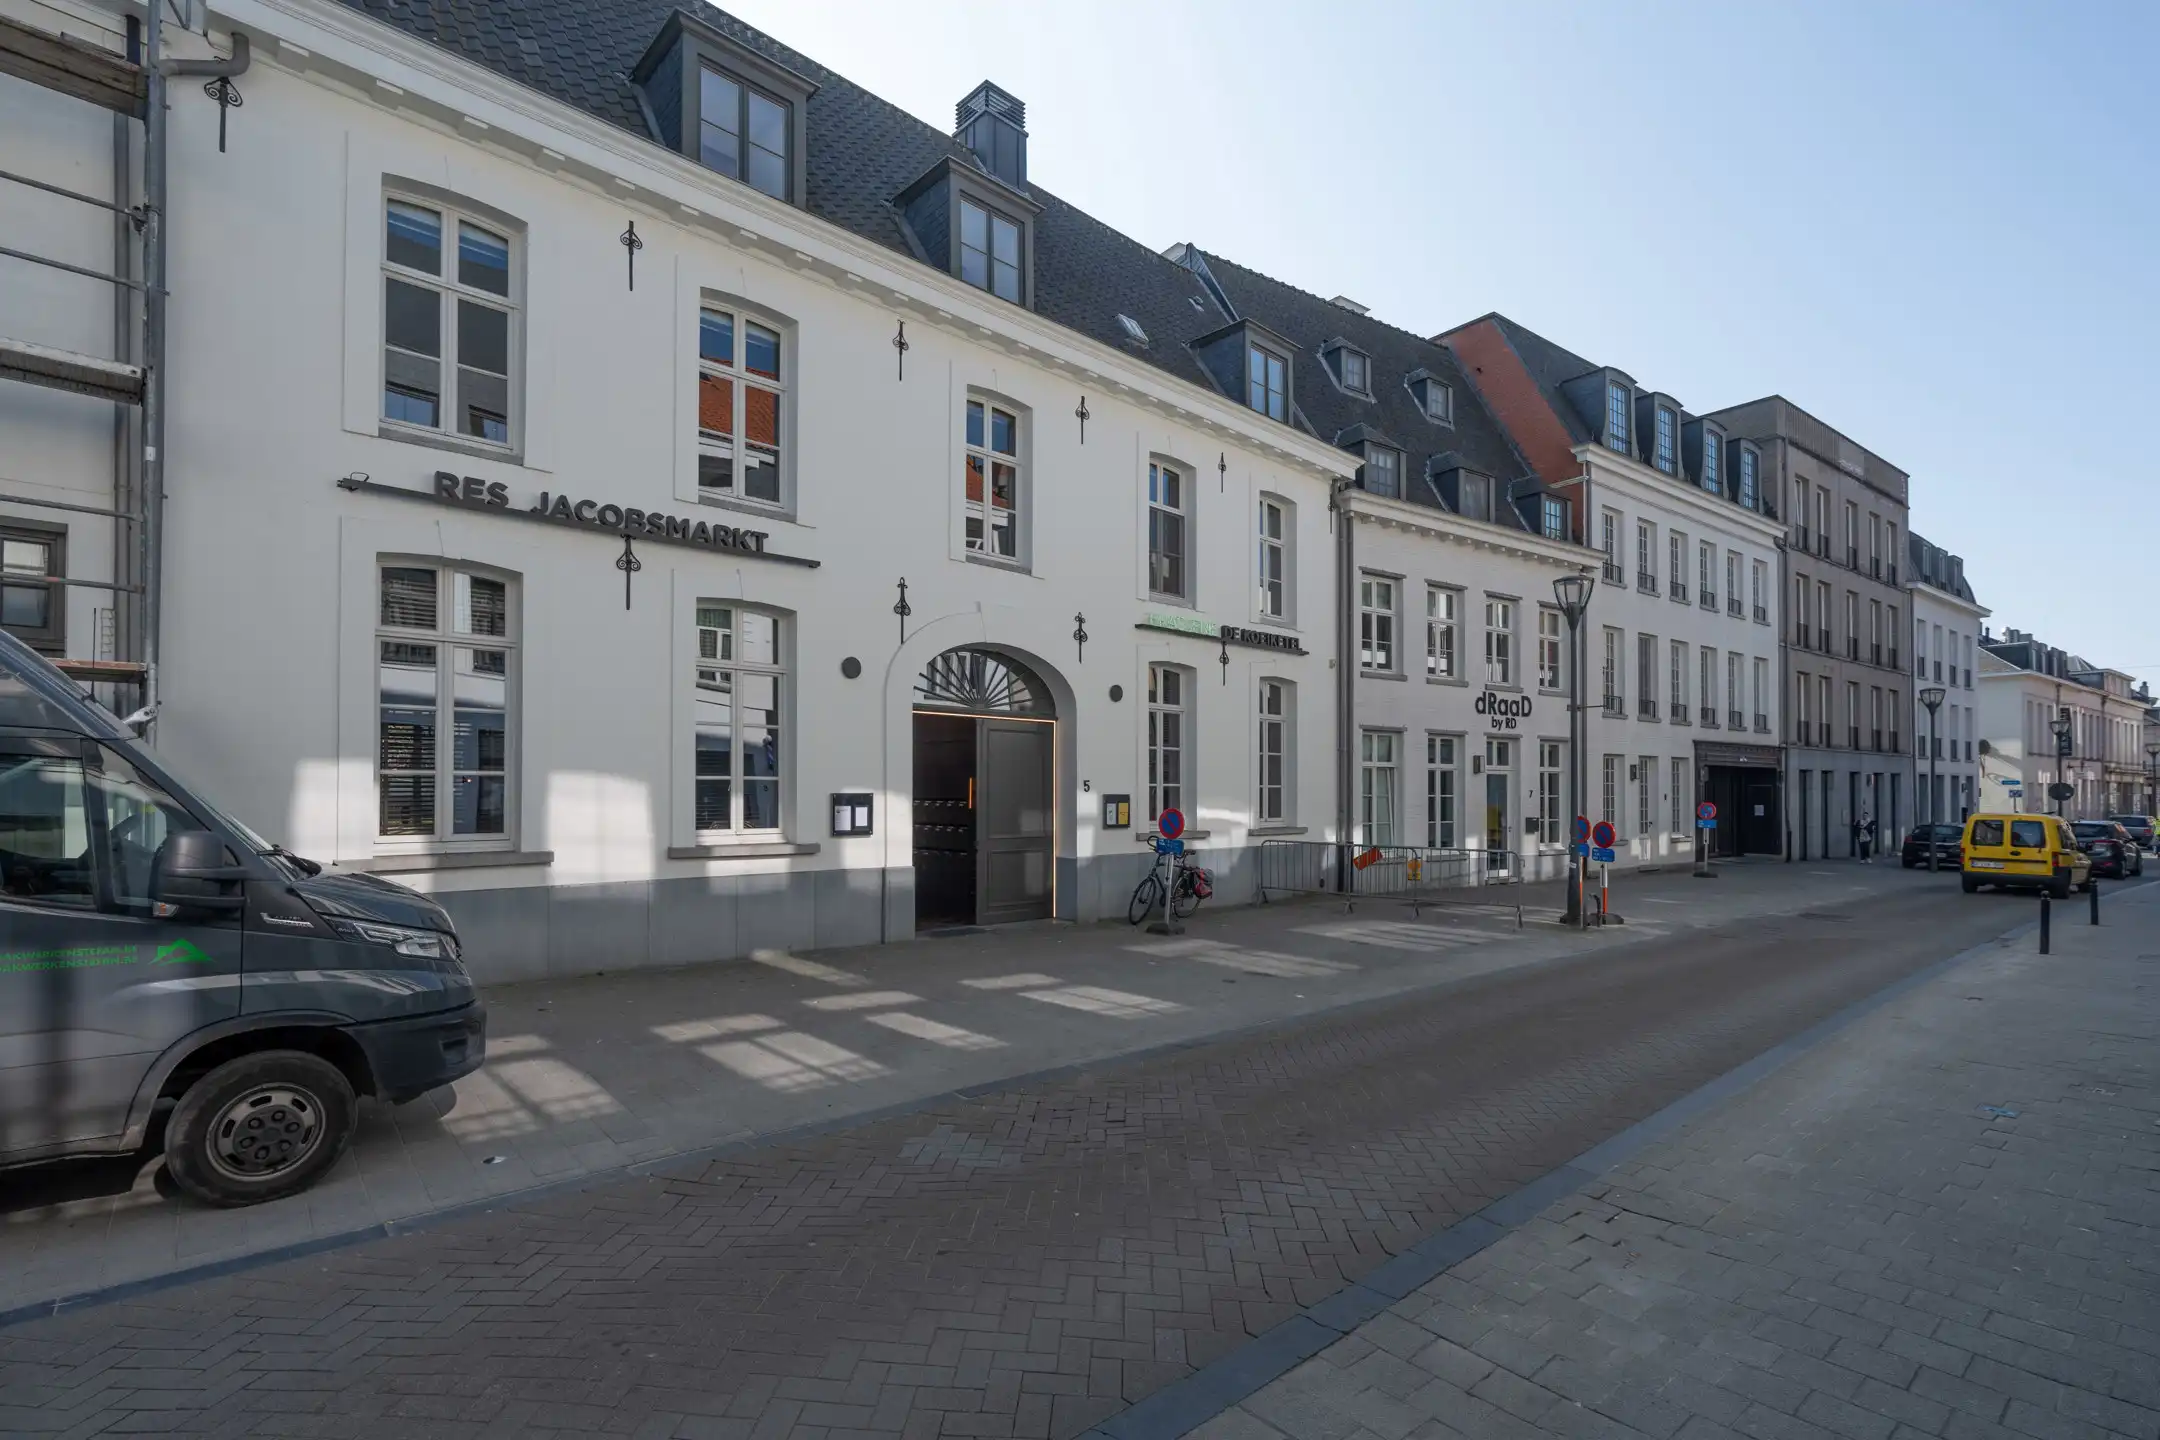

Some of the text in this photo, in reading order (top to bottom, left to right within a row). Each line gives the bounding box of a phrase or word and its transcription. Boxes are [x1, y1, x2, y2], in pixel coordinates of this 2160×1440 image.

[434, 471, 768, 553] RES JACOBSMARKT
[1221, 625, 1240, 640] DE
[1475, 691, 1532, 717] dRaaD
[1491, 716, 1517, 730] by RD
[1083, 780, 1090, 792] 5
